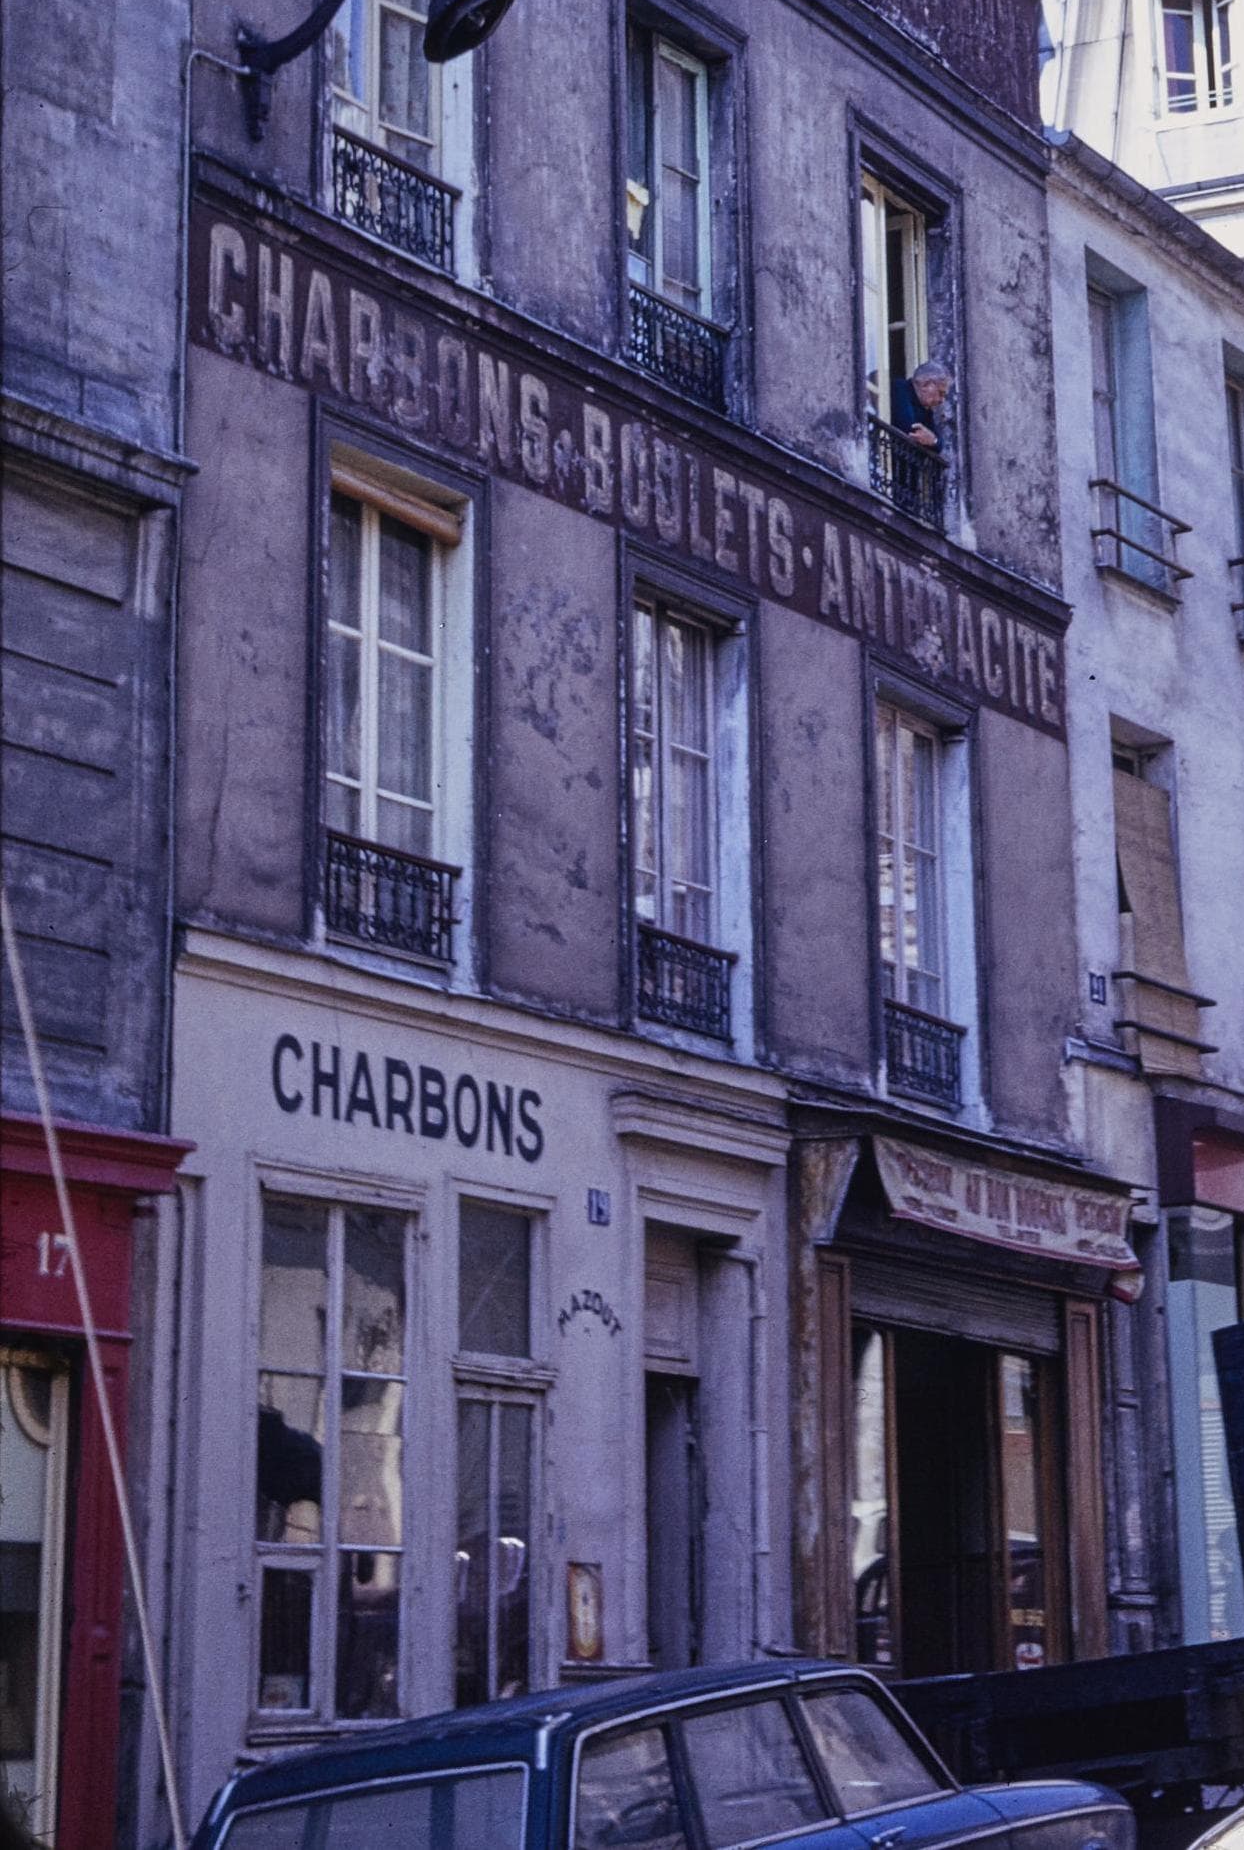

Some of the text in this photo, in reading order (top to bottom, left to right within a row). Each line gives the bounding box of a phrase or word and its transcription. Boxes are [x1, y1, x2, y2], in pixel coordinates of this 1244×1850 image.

[209, 222, 1061, 727] CHARBONS BOULETS ANTHRACITE
[272, 1033, 544, 1163] CHARBONS
[557, 1289, 622, 1337] MAZOUT
